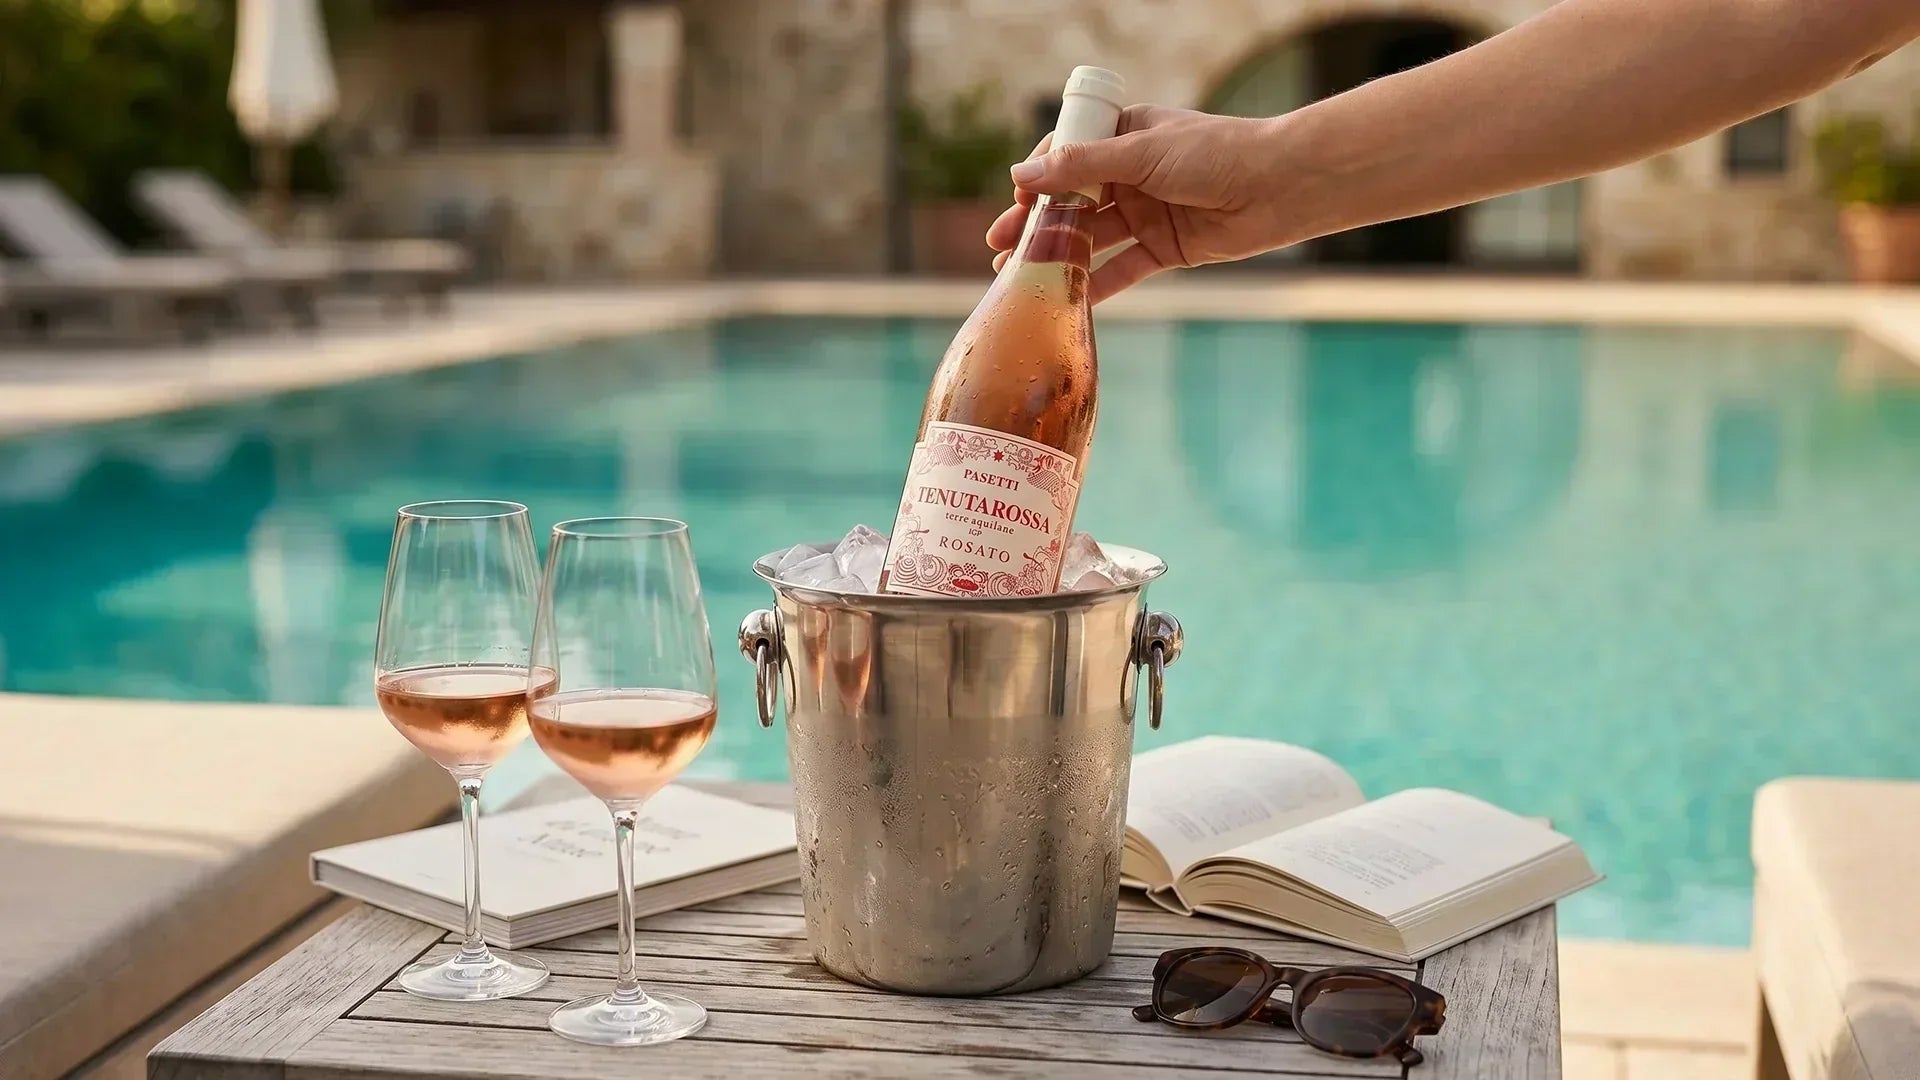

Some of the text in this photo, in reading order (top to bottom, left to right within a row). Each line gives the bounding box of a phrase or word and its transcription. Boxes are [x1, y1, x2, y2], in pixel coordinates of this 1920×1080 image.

[964, 469, 1019, 491] PASETTI
[918, 487, 1050, 534] TENUTAROSSA
[945, 512, 1015, 535] terre aquilane
[968, 528, 982, 536] IGP
[939, 536, 1010, 563] ROSATO
